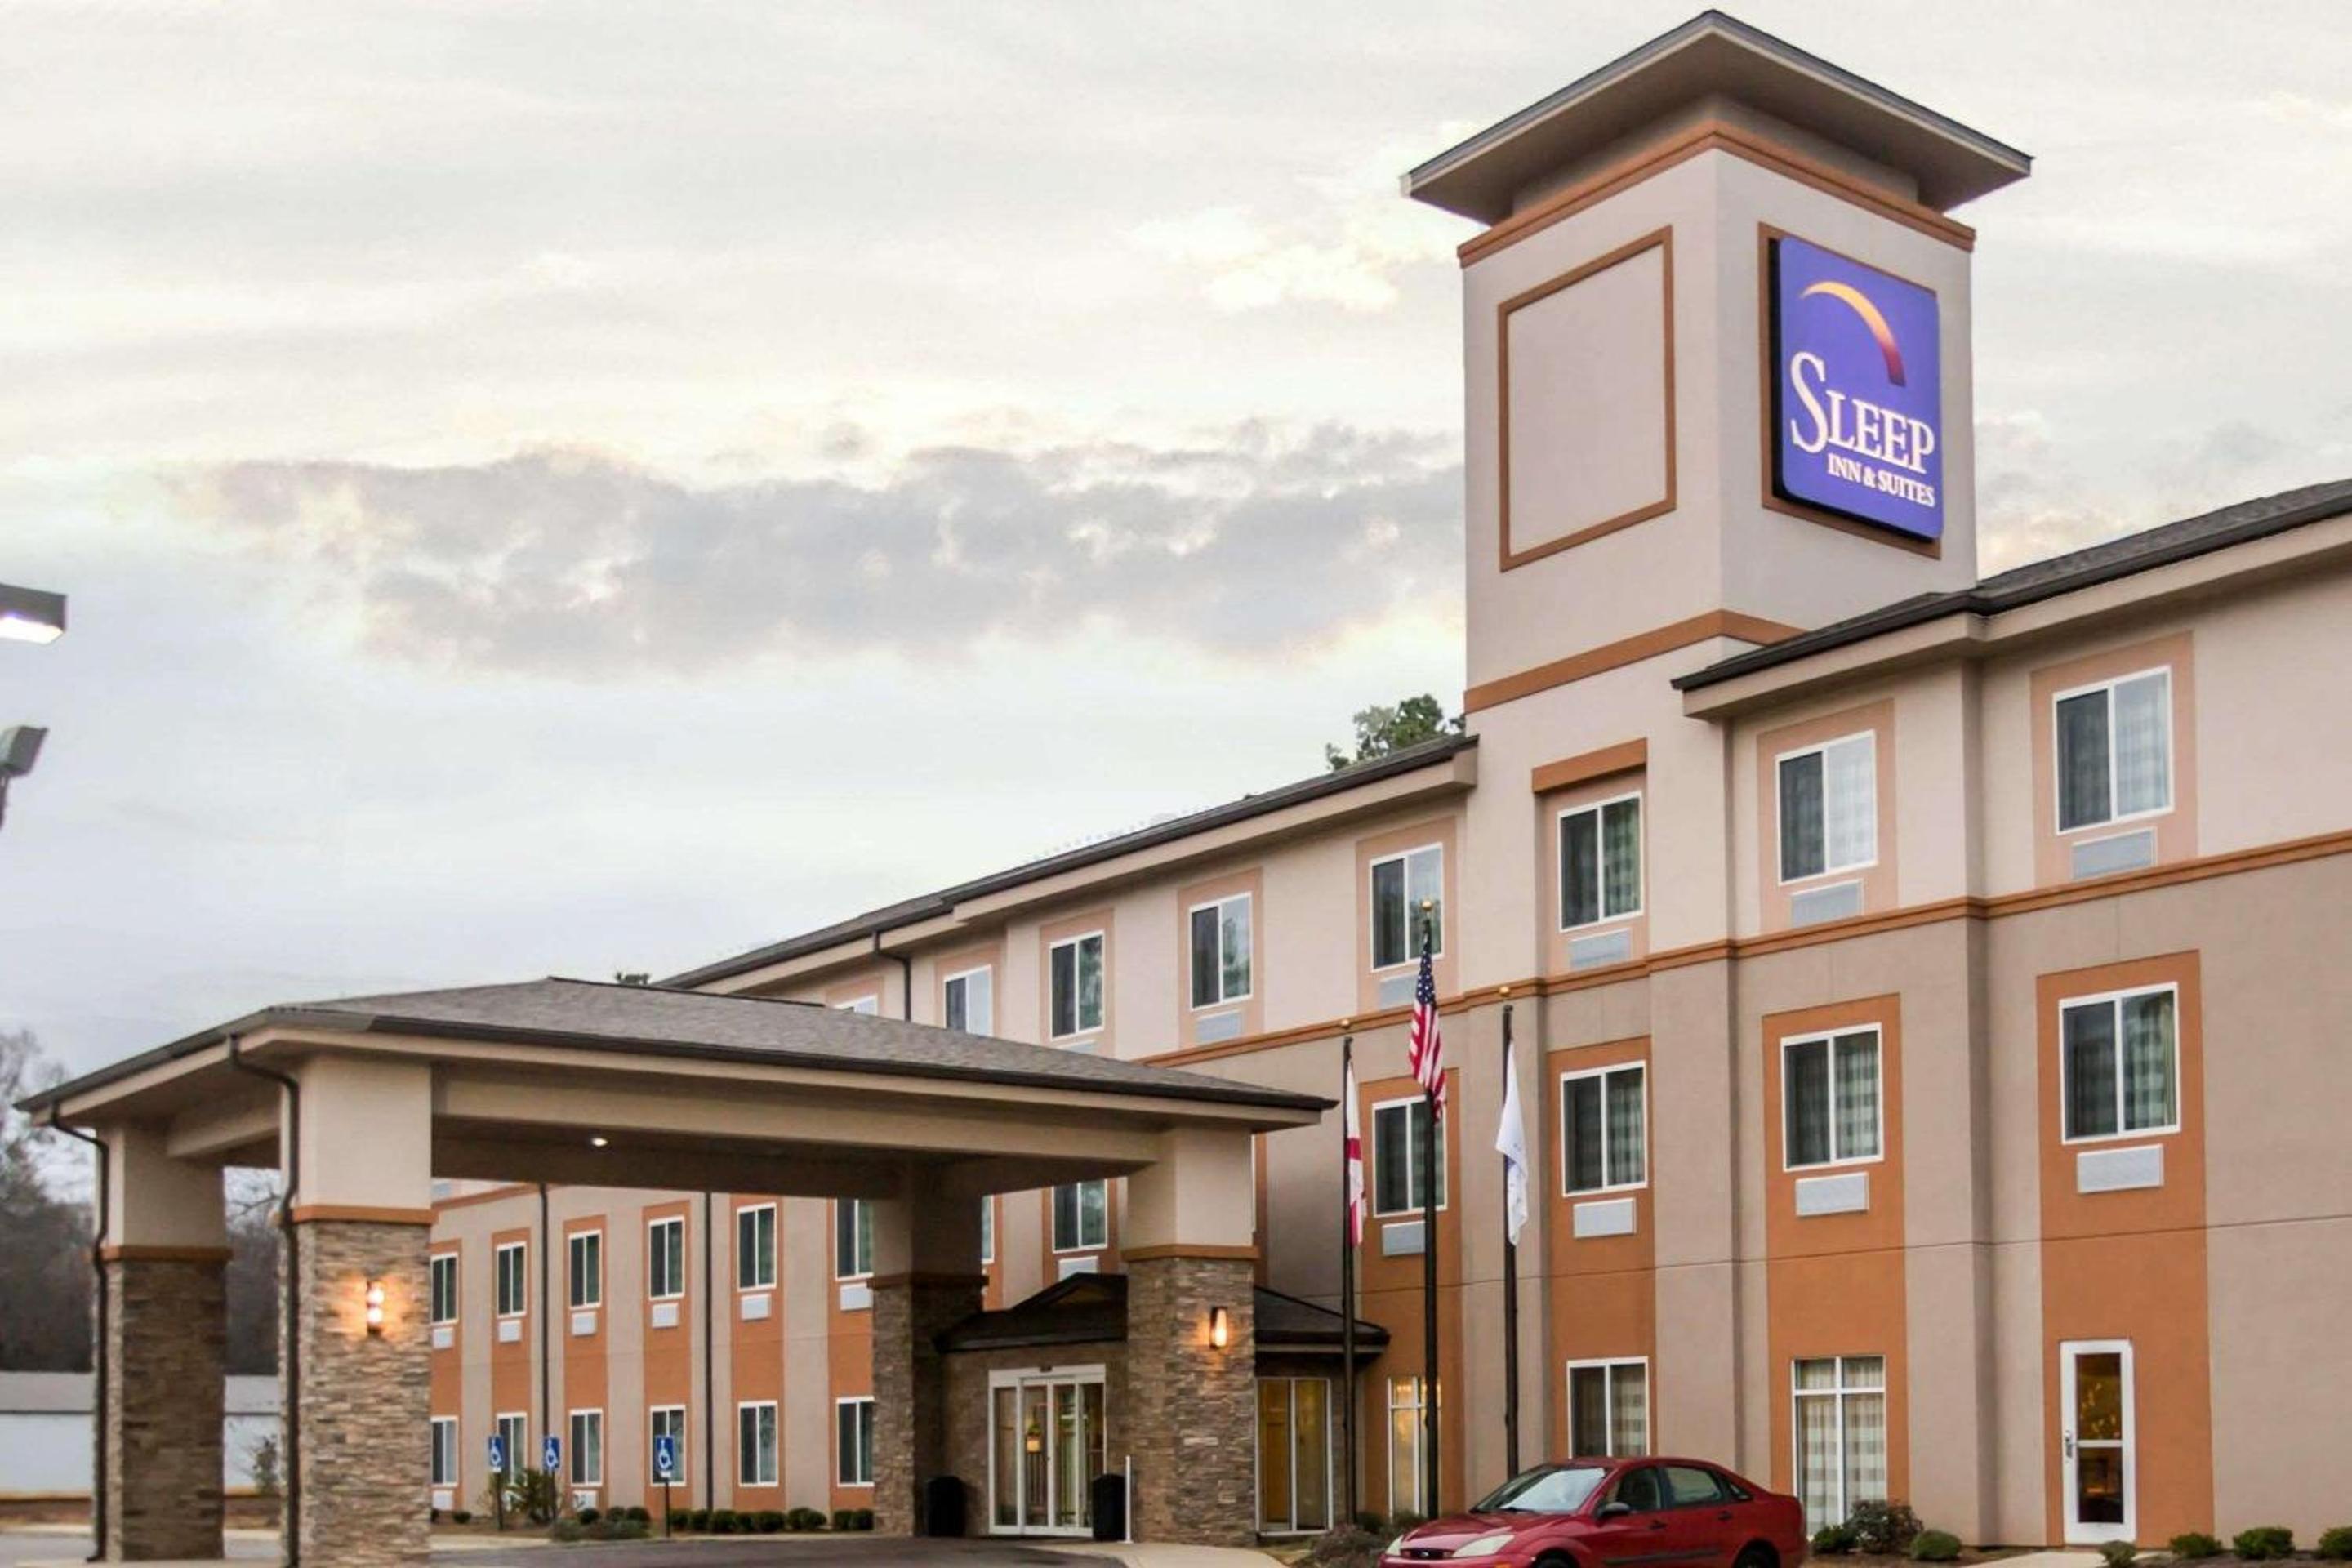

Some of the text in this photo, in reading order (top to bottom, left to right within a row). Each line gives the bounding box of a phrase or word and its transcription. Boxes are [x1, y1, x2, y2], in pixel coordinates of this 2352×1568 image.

[1791, 351, 1936, 474] SLEEP
[1828, 452, 1936, 507] INN & SUITES
